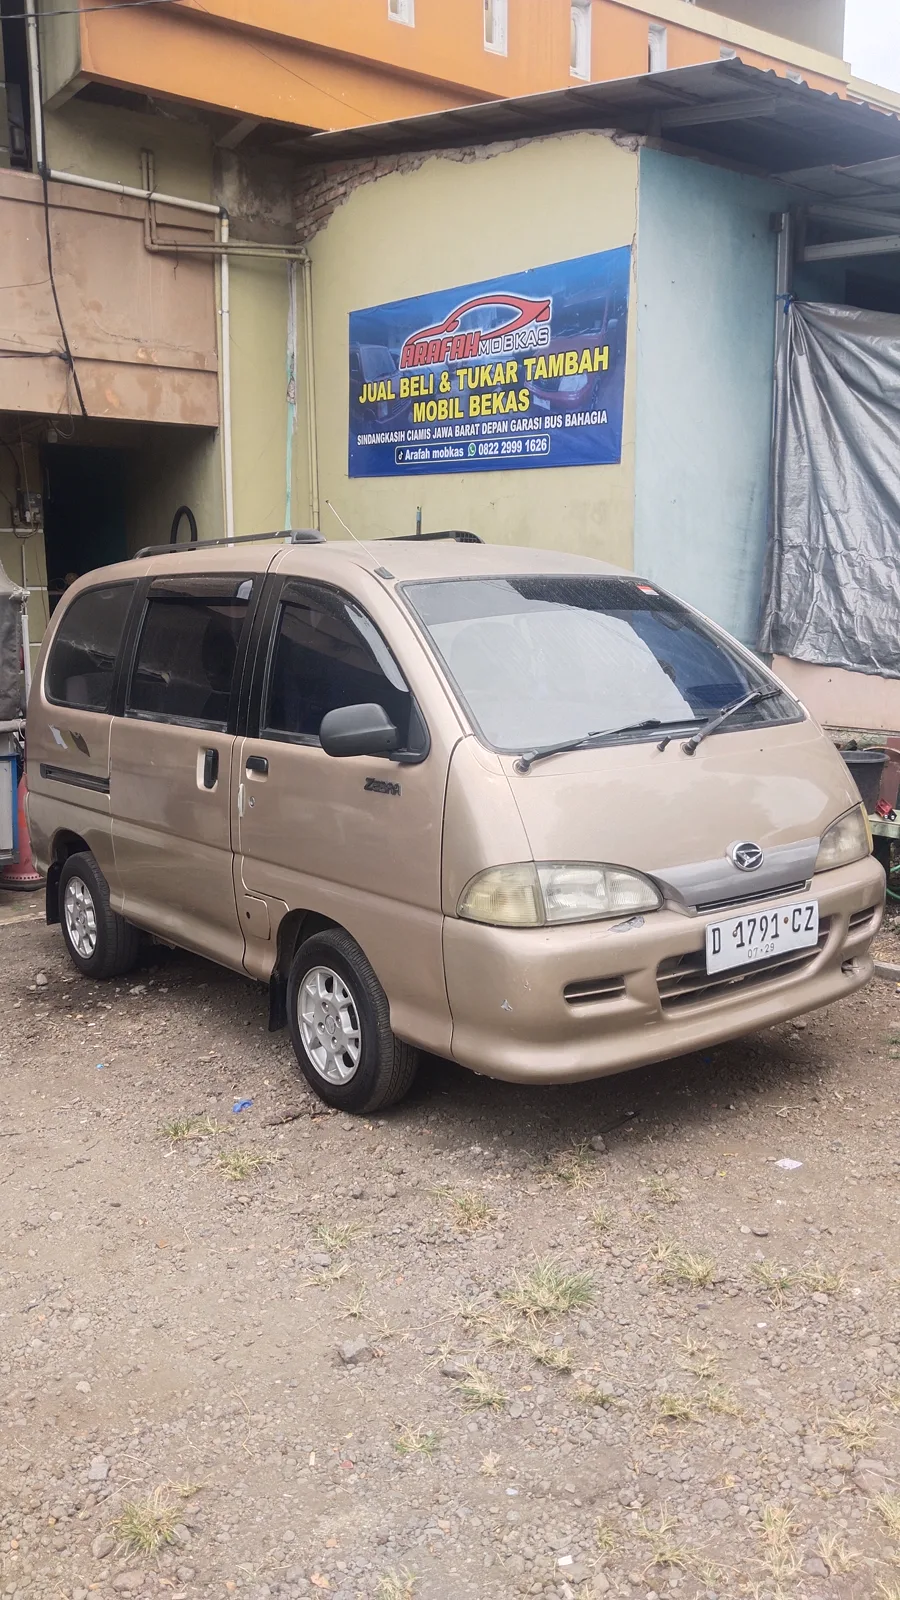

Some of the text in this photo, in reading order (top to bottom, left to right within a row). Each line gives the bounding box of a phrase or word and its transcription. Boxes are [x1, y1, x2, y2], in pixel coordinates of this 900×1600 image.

[400, 328, 550, 370] ARAFAH MOBKAS
[358, 346, 609, 404] JUAL BELI & TUKAR TAMBAH
[413, 389, 530, 423] MOBIL BEKAS
[357, 410, 608, 446] SINDANGKASIH CIAMIS JAWA BARAT DEPAN GARASI BUS BAHAGIA
[404, 438, 547, 461] Arafah mobkas 0822 2999 1626
[712, 905, 814, 954] D 1791 CZ
